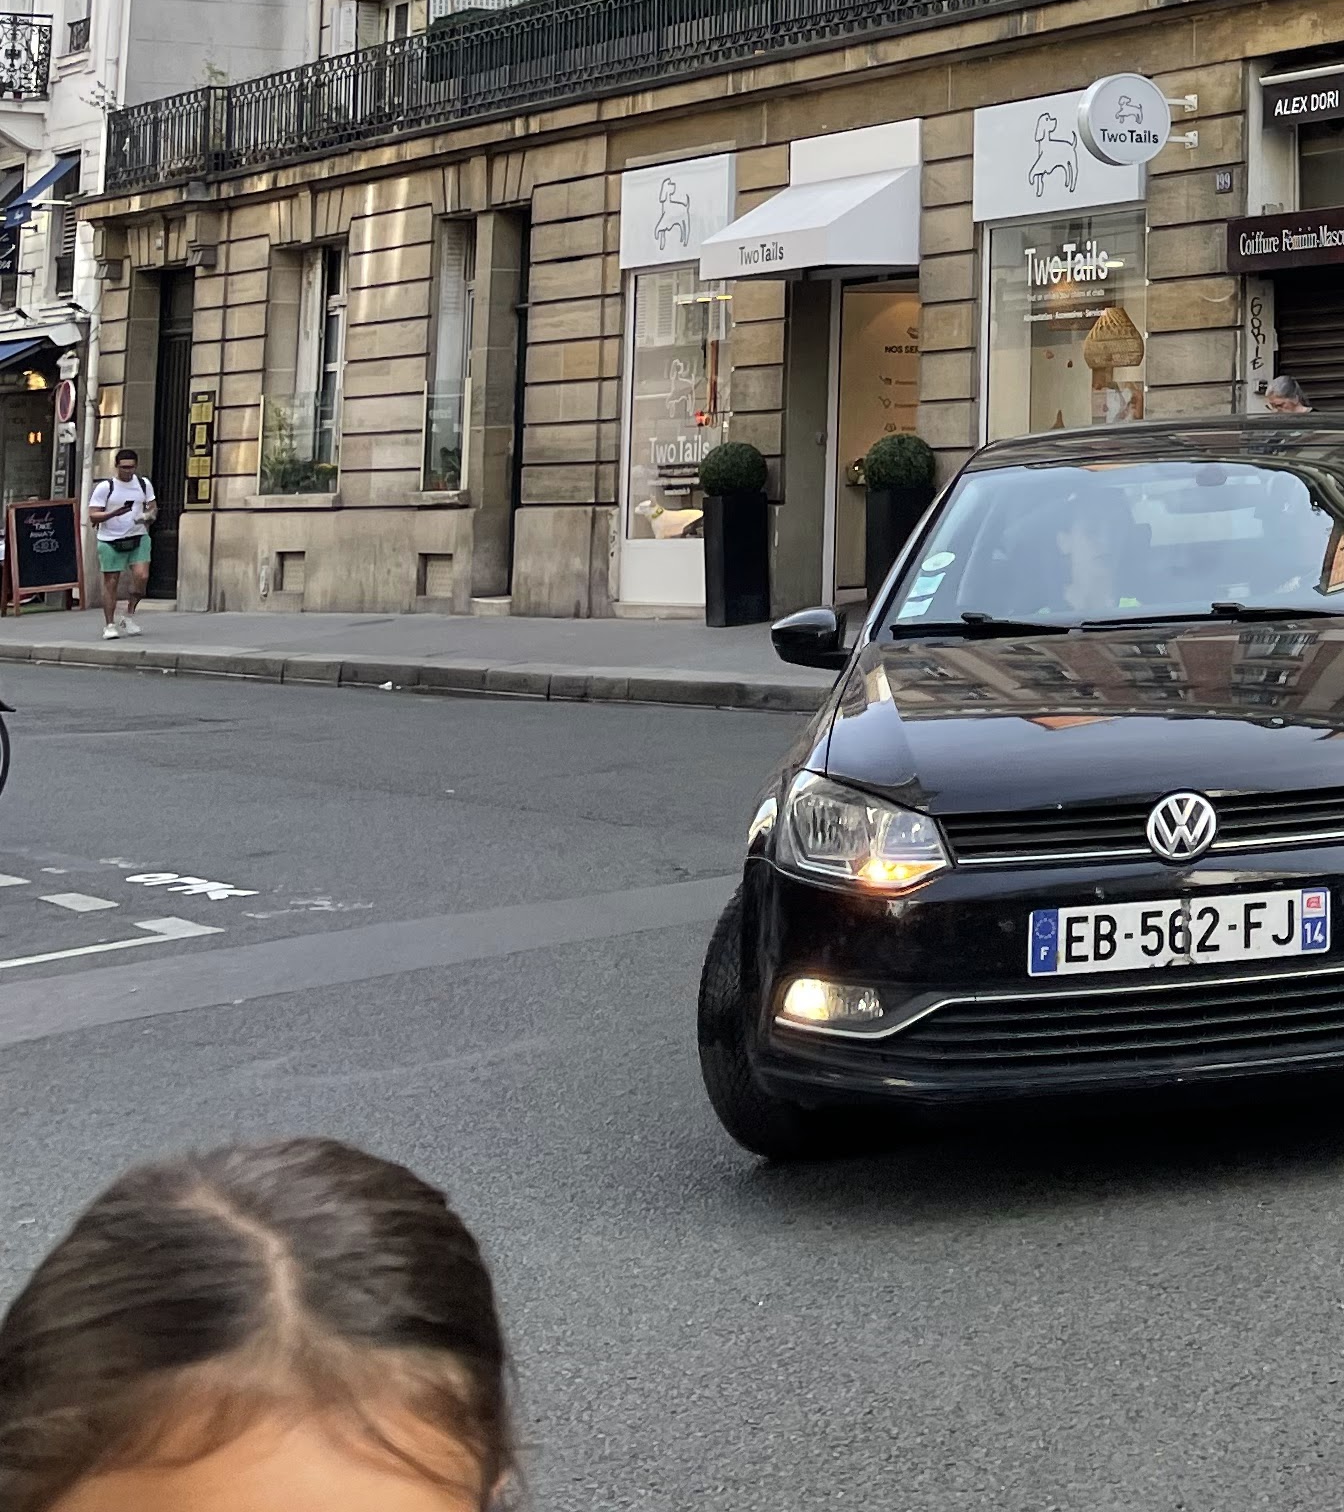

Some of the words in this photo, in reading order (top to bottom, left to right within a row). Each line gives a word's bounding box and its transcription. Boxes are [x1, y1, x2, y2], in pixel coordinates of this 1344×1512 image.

[1274, 95, 1308, 117] ALEX
[1310, 90, 1339, 112] DORI
[1216, 172, 1231, 191] 199
[1239, 230, 1280, 256] Coiffure
[1039, 946, 1050, 961] F
[1304, 921, 1325, 944] 14
